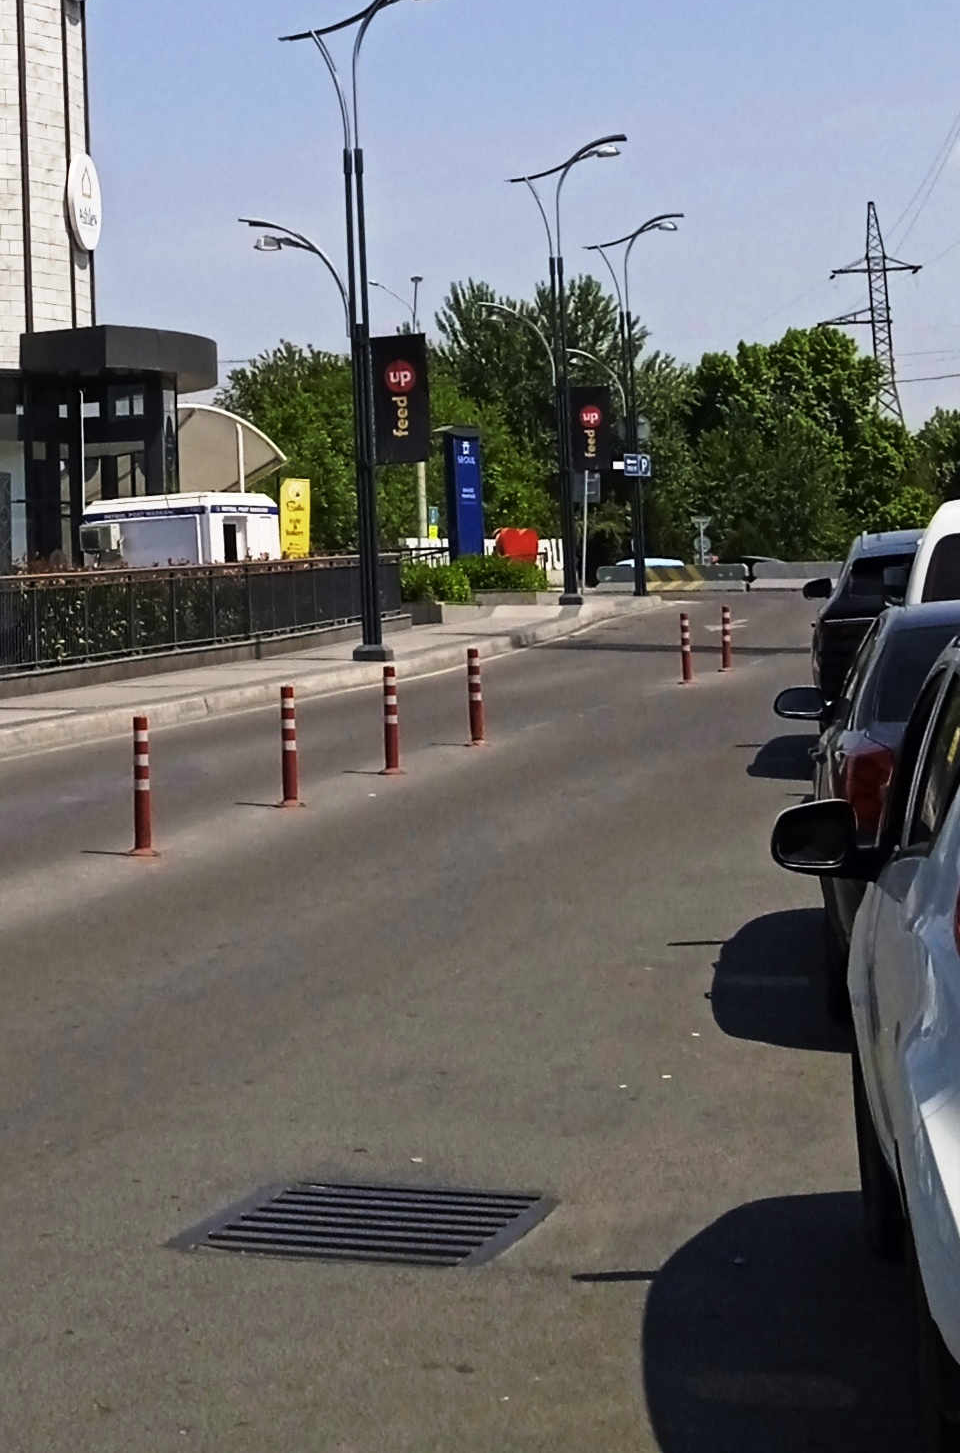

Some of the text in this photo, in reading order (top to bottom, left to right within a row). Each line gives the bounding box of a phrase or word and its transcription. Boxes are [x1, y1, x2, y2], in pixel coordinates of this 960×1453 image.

[389, 370, 411, 387] up
[391, 396, 409, 437] feed
[582, 412, 599, 424] up
[583, 429, 596, 458] feed
